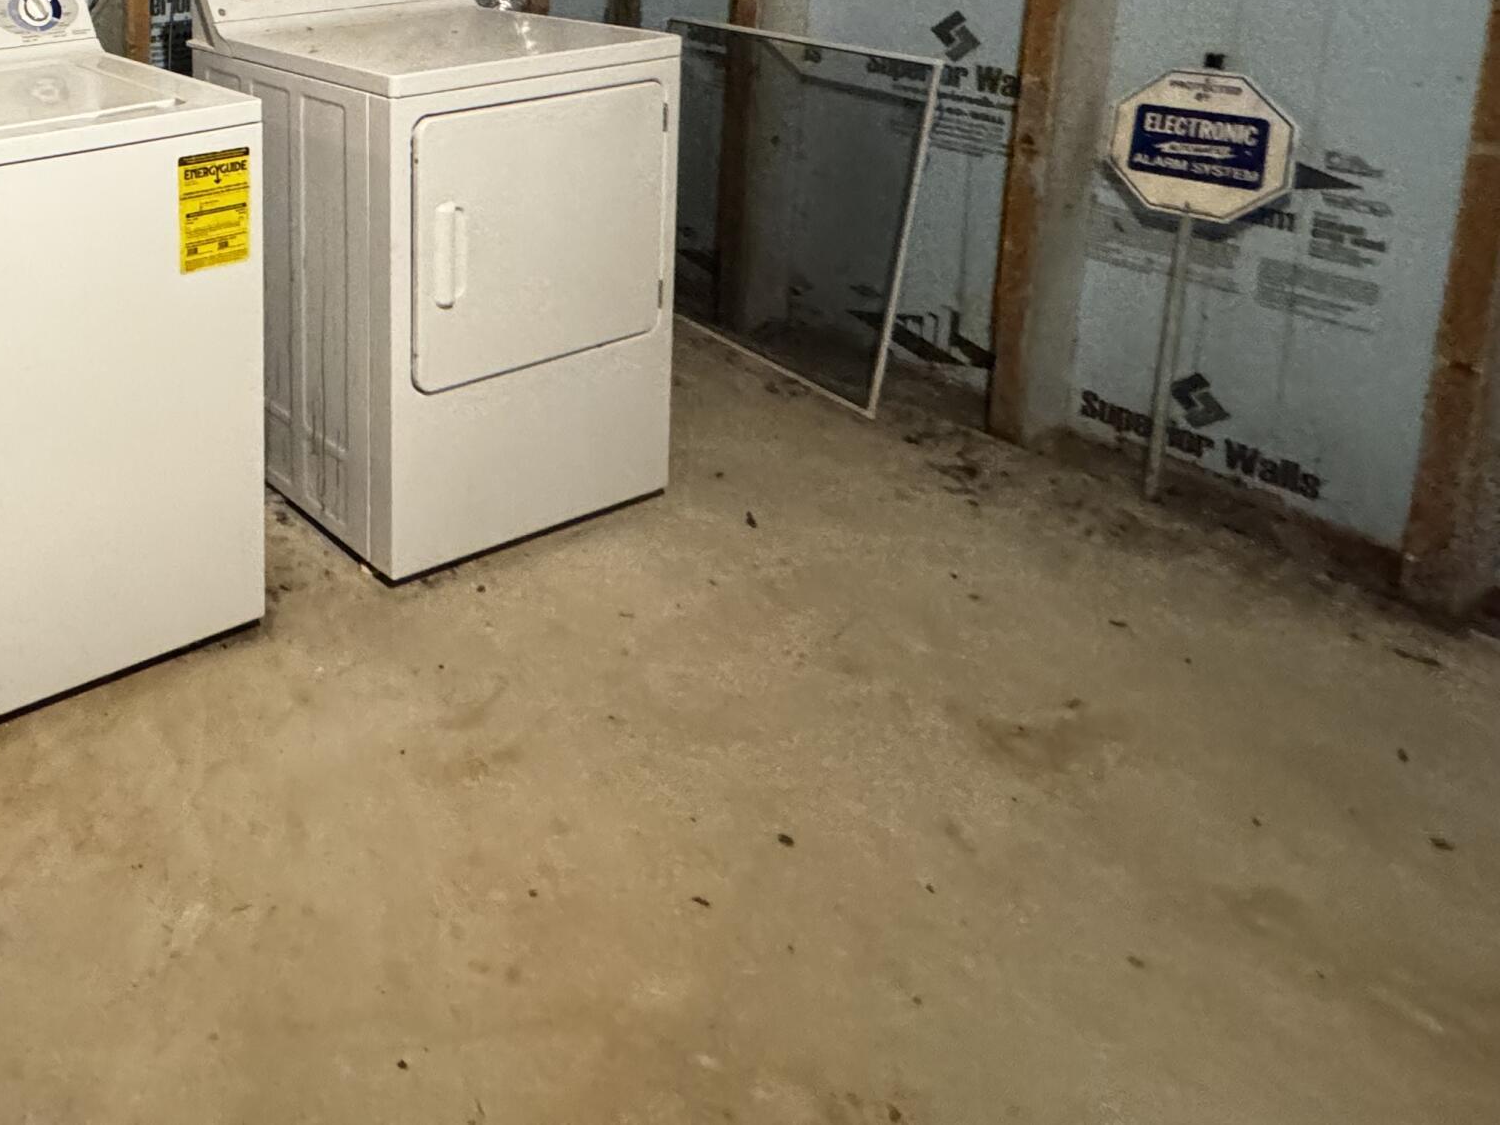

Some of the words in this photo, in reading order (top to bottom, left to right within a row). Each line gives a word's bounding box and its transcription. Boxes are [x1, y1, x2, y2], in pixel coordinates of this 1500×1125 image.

[1143, 112, 1260, 147] ELECTRONIC
[184, 159, 247, 181] ENERGYGUIDE
[1132, 153, 1189, 171] ALARM
[1190, 163, 1259, 182] SYSTEM
[1224, 437, 1321, 500] Walls
